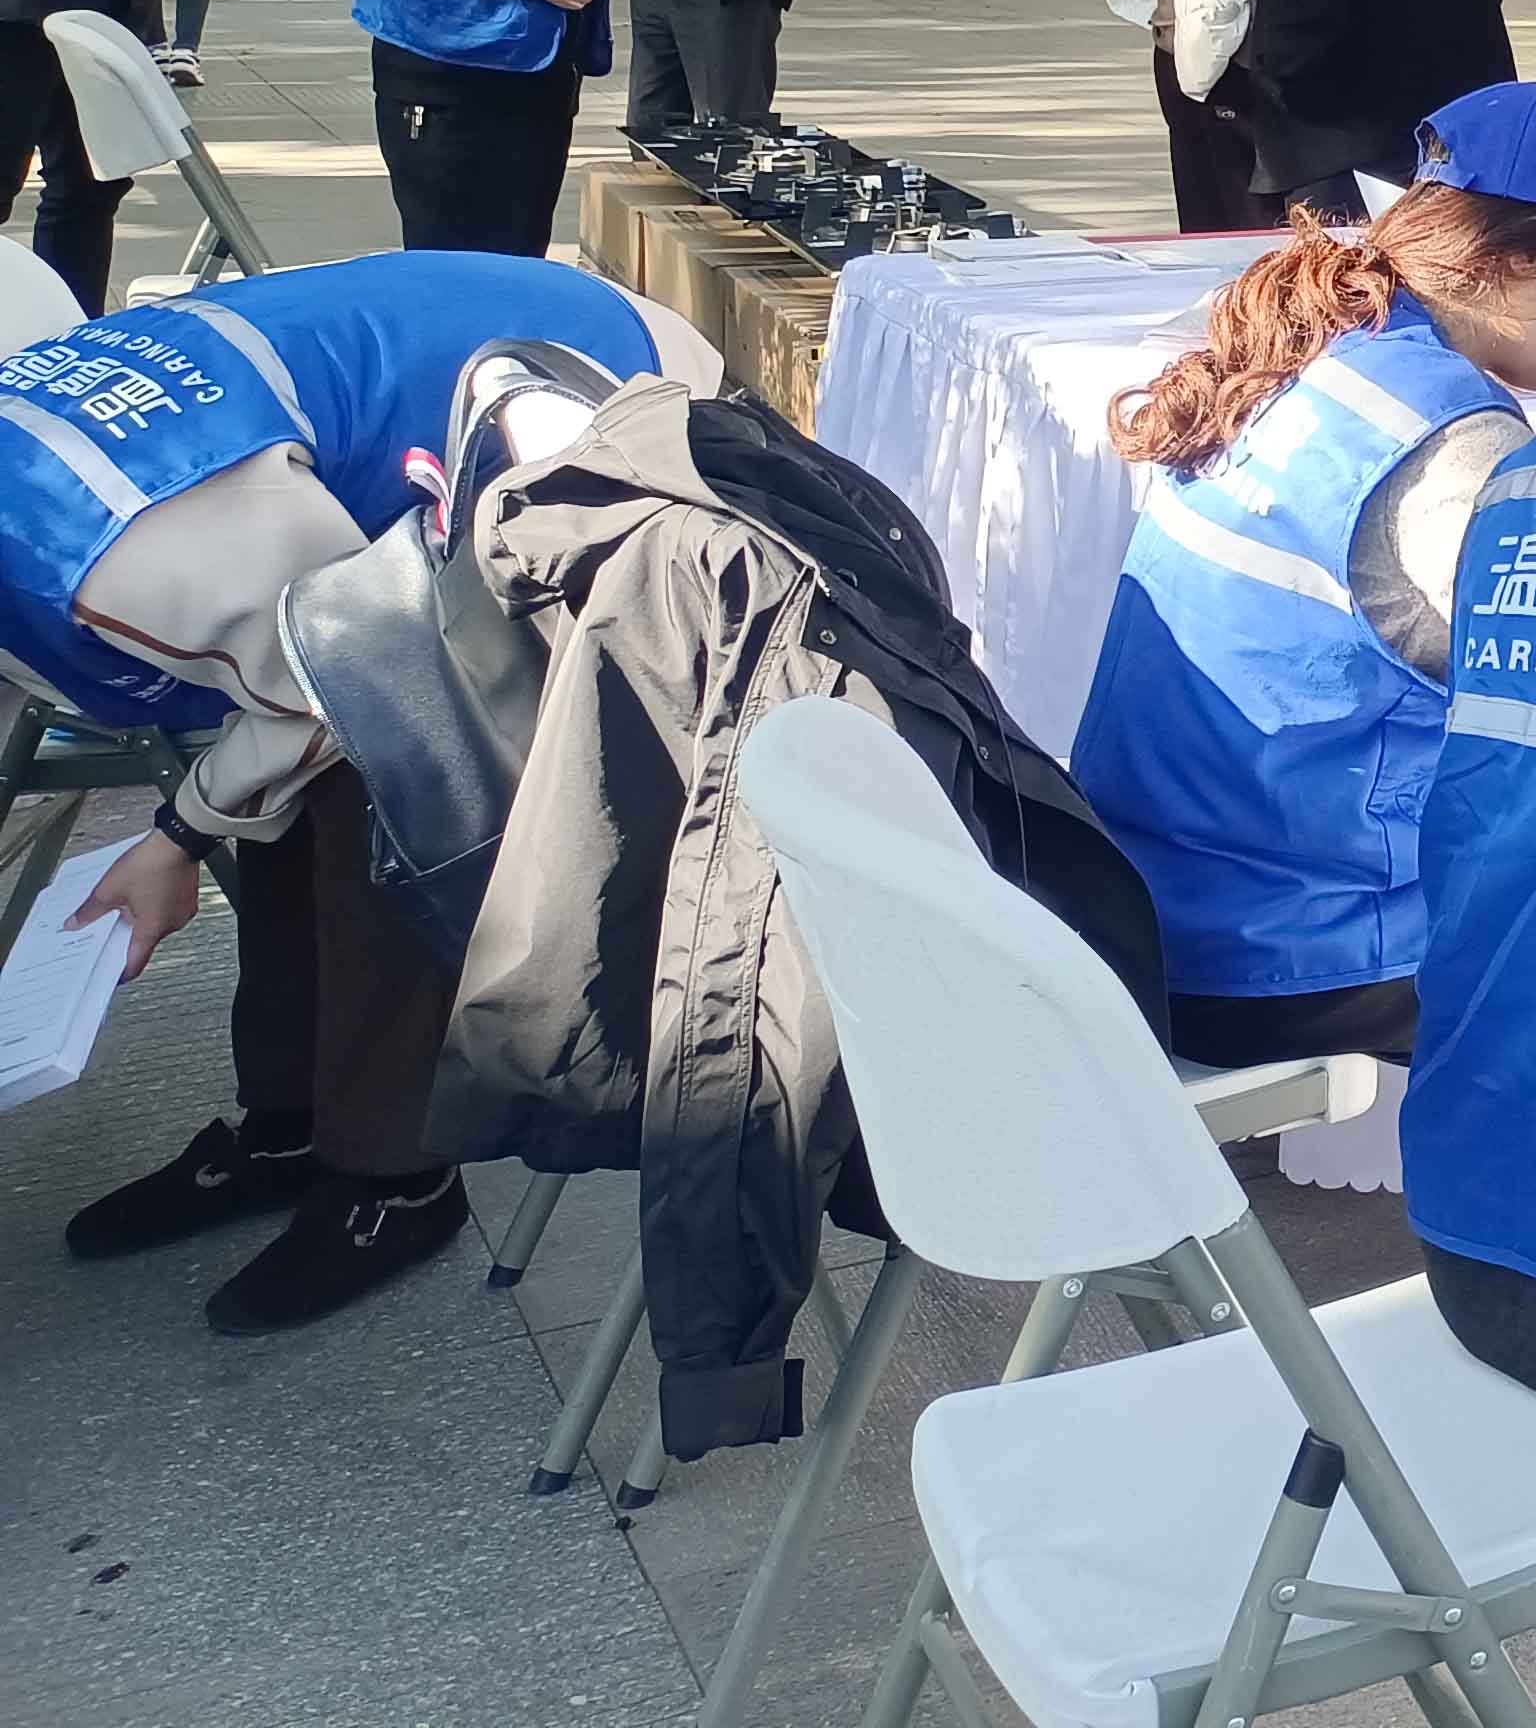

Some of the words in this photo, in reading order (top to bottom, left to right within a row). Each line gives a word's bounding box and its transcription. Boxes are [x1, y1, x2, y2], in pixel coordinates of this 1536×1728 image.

[0, 345, 183, 440] 温度管
[124, 334, 226, 404] CARING
